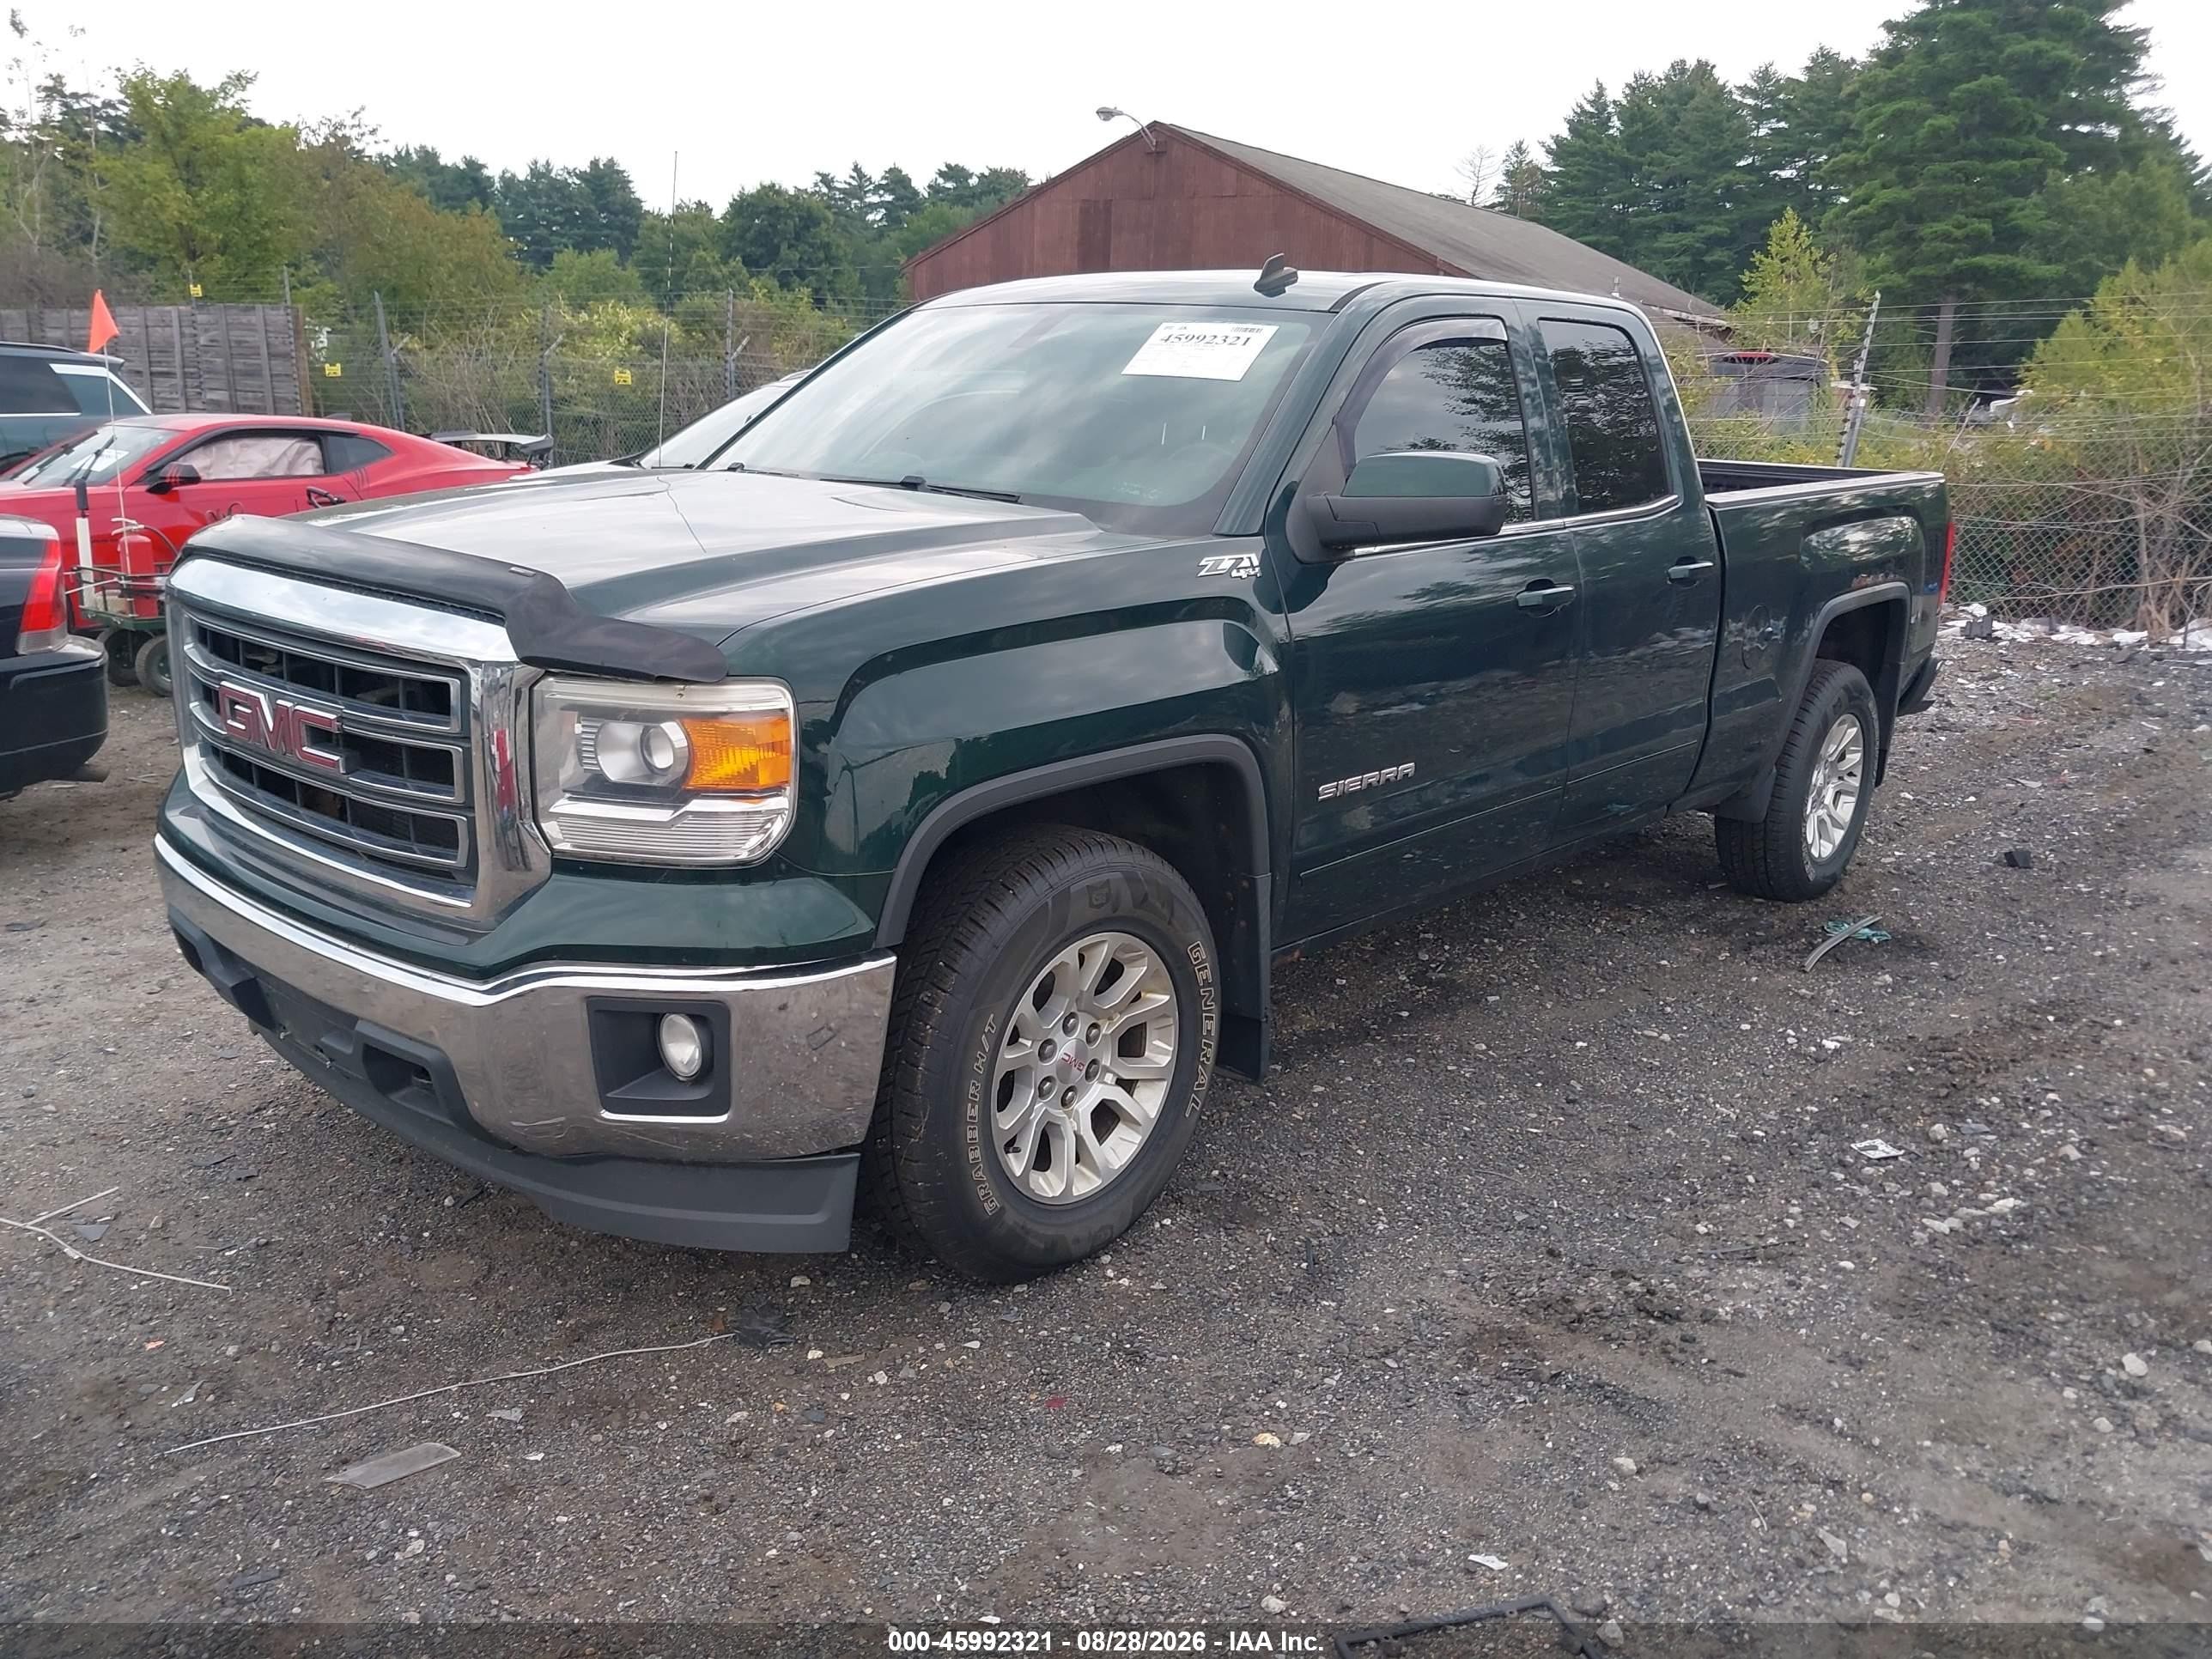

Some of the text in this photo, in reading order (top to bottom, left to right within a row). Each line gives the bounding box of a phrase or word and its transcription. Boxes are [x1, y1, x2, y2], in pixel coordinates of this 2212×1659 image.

[1160, 333, 1251, 346] 45992321
[219, 681, 346, 774] GMC
[1318, 762, 1415, 802] SIERRA
[1061, 1052, 1085, 1072] GMC
[1185, 940, 1216, 1118] GENERAL
[966, 1013, 1000, 1216] GRABBER H/T
